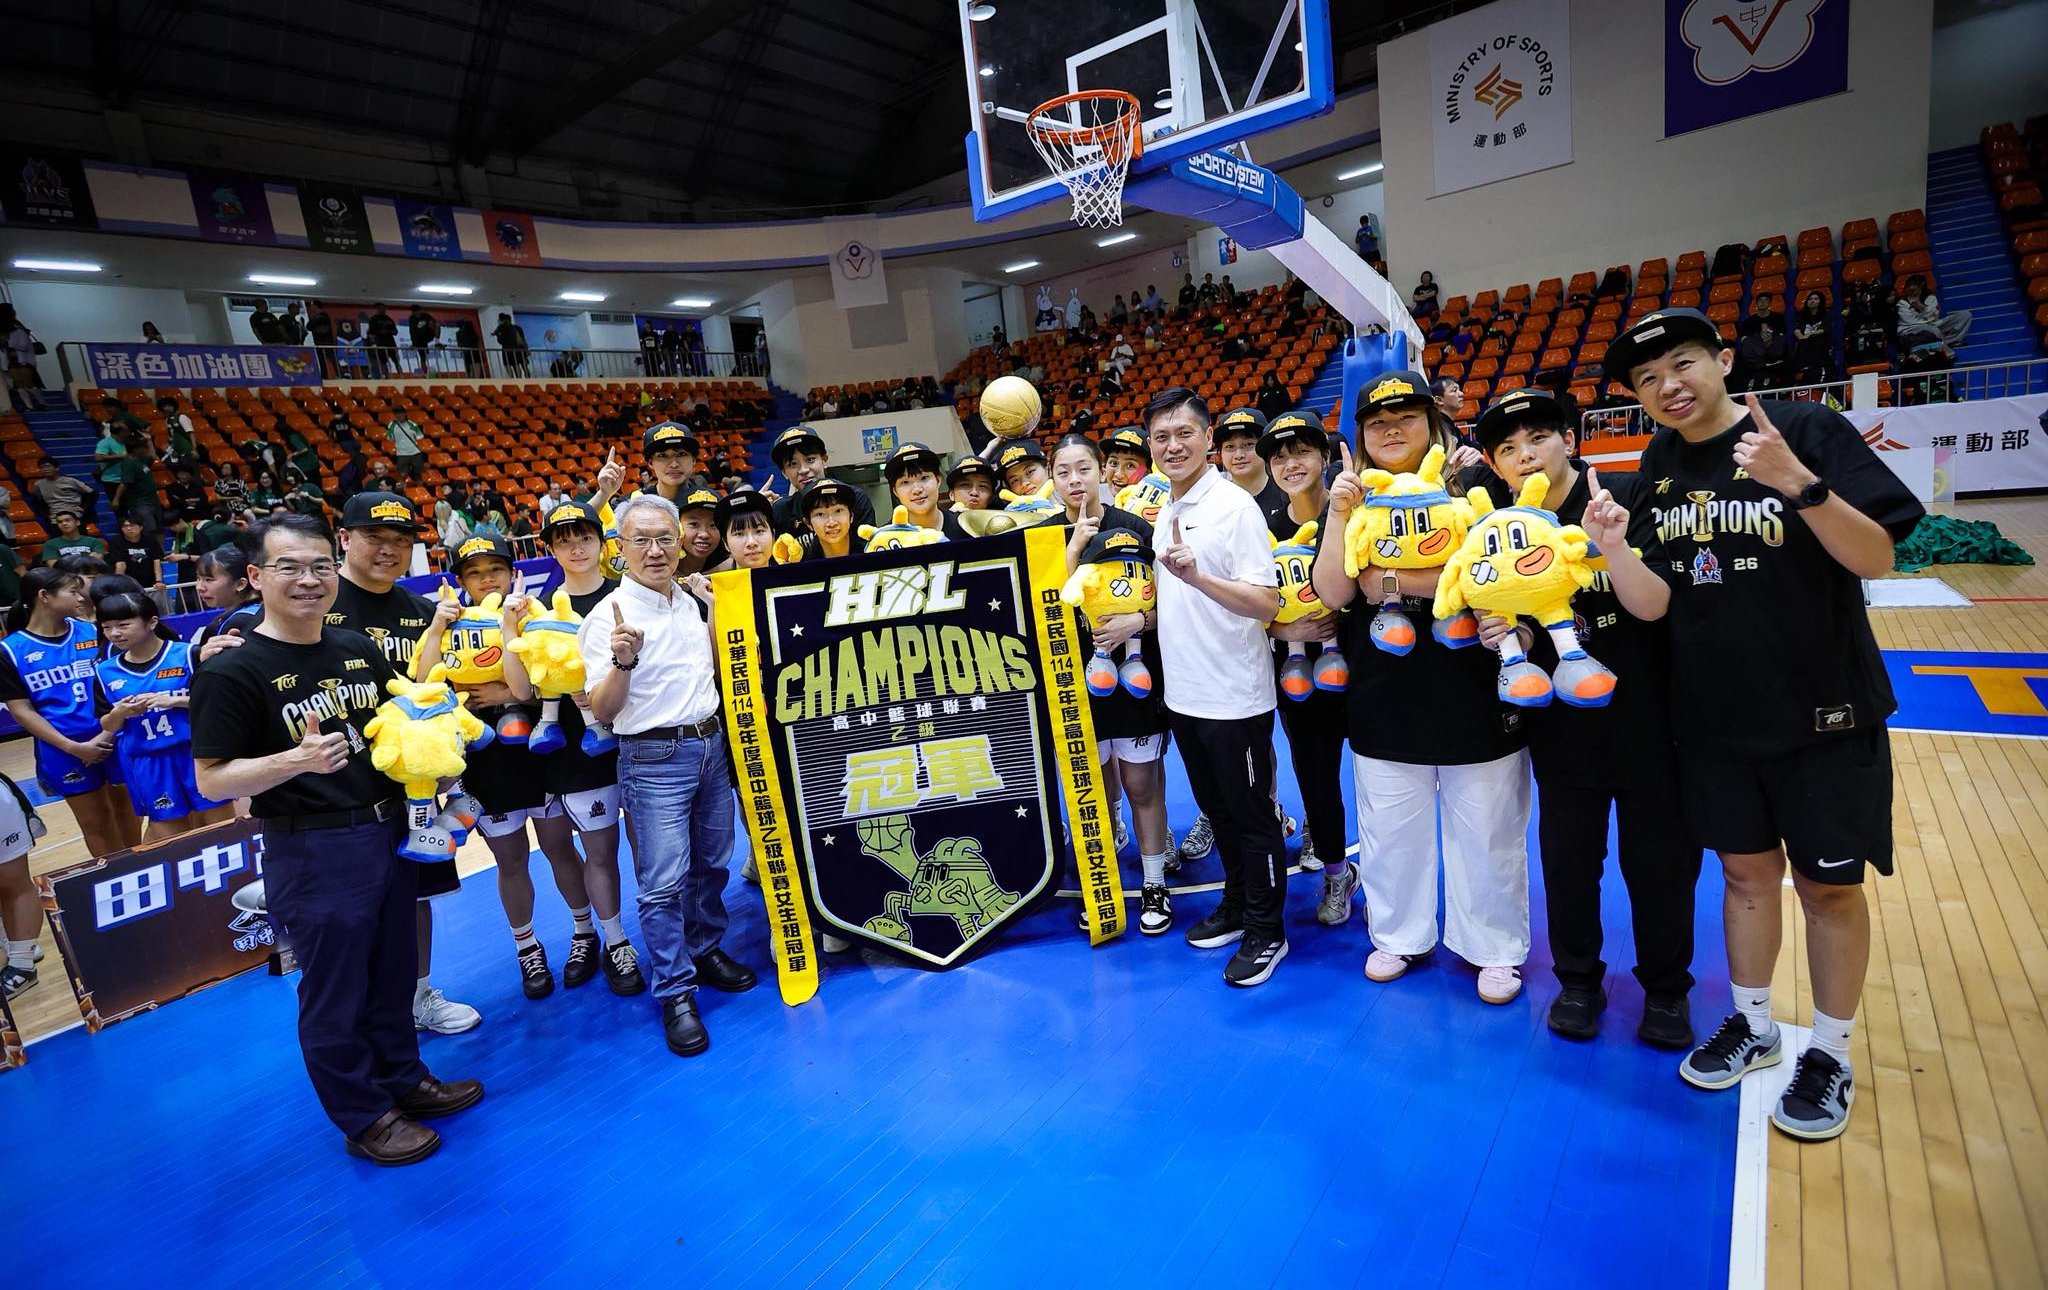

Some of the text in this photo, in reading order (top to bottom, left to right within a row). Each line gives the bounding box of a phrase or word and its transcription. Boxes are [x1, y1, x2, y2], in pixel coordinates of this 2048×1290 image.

[1446, 35, 1554, 124] MINISTRY OF SPORTS
[1473, 122, 1527, 148] 運動部
[95, 352, 274, 381] 深色加油團
[1733, 557, 1759, 571] 26
[824, 561, 968, 627] HBL
[1596, 612, 1617, 629] 26
[775, 625, 1037, 724] CHAMPIONS
[72, 682, 89, 703] 9
[141, 714, 174, 741] 14
[832, 696, 988, 731] 高中籃球聯賽
[890, 721, 936, 742] 乙級
[839, 734, 1006, 818] 冠軍
[727, 629, 807, 973] 中華民國114學年度高中籃球乙級聯賽女生組冠軍
